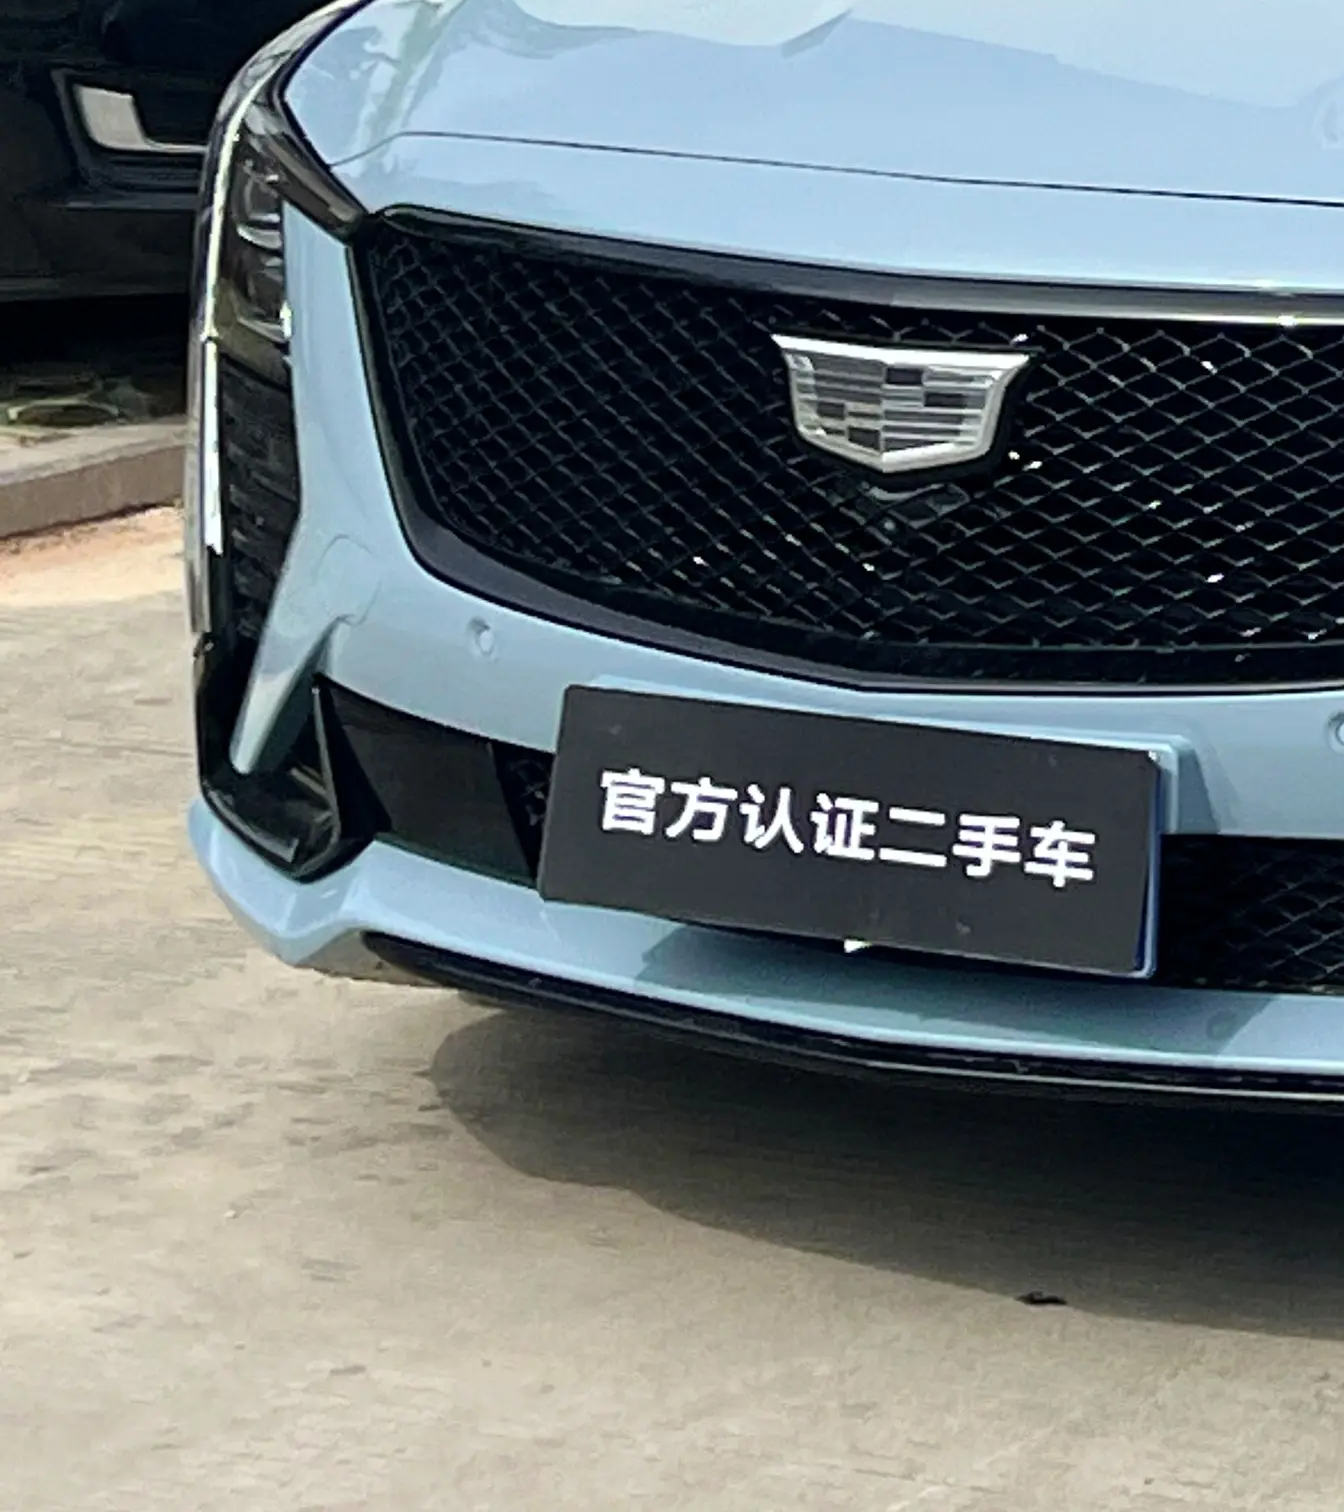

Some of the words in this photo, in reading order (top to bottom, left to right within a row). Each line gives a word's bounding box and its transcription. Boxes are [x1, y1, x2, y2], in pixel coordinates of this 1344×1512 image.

[600, 767, 1097, 889] 官方认证二手车
